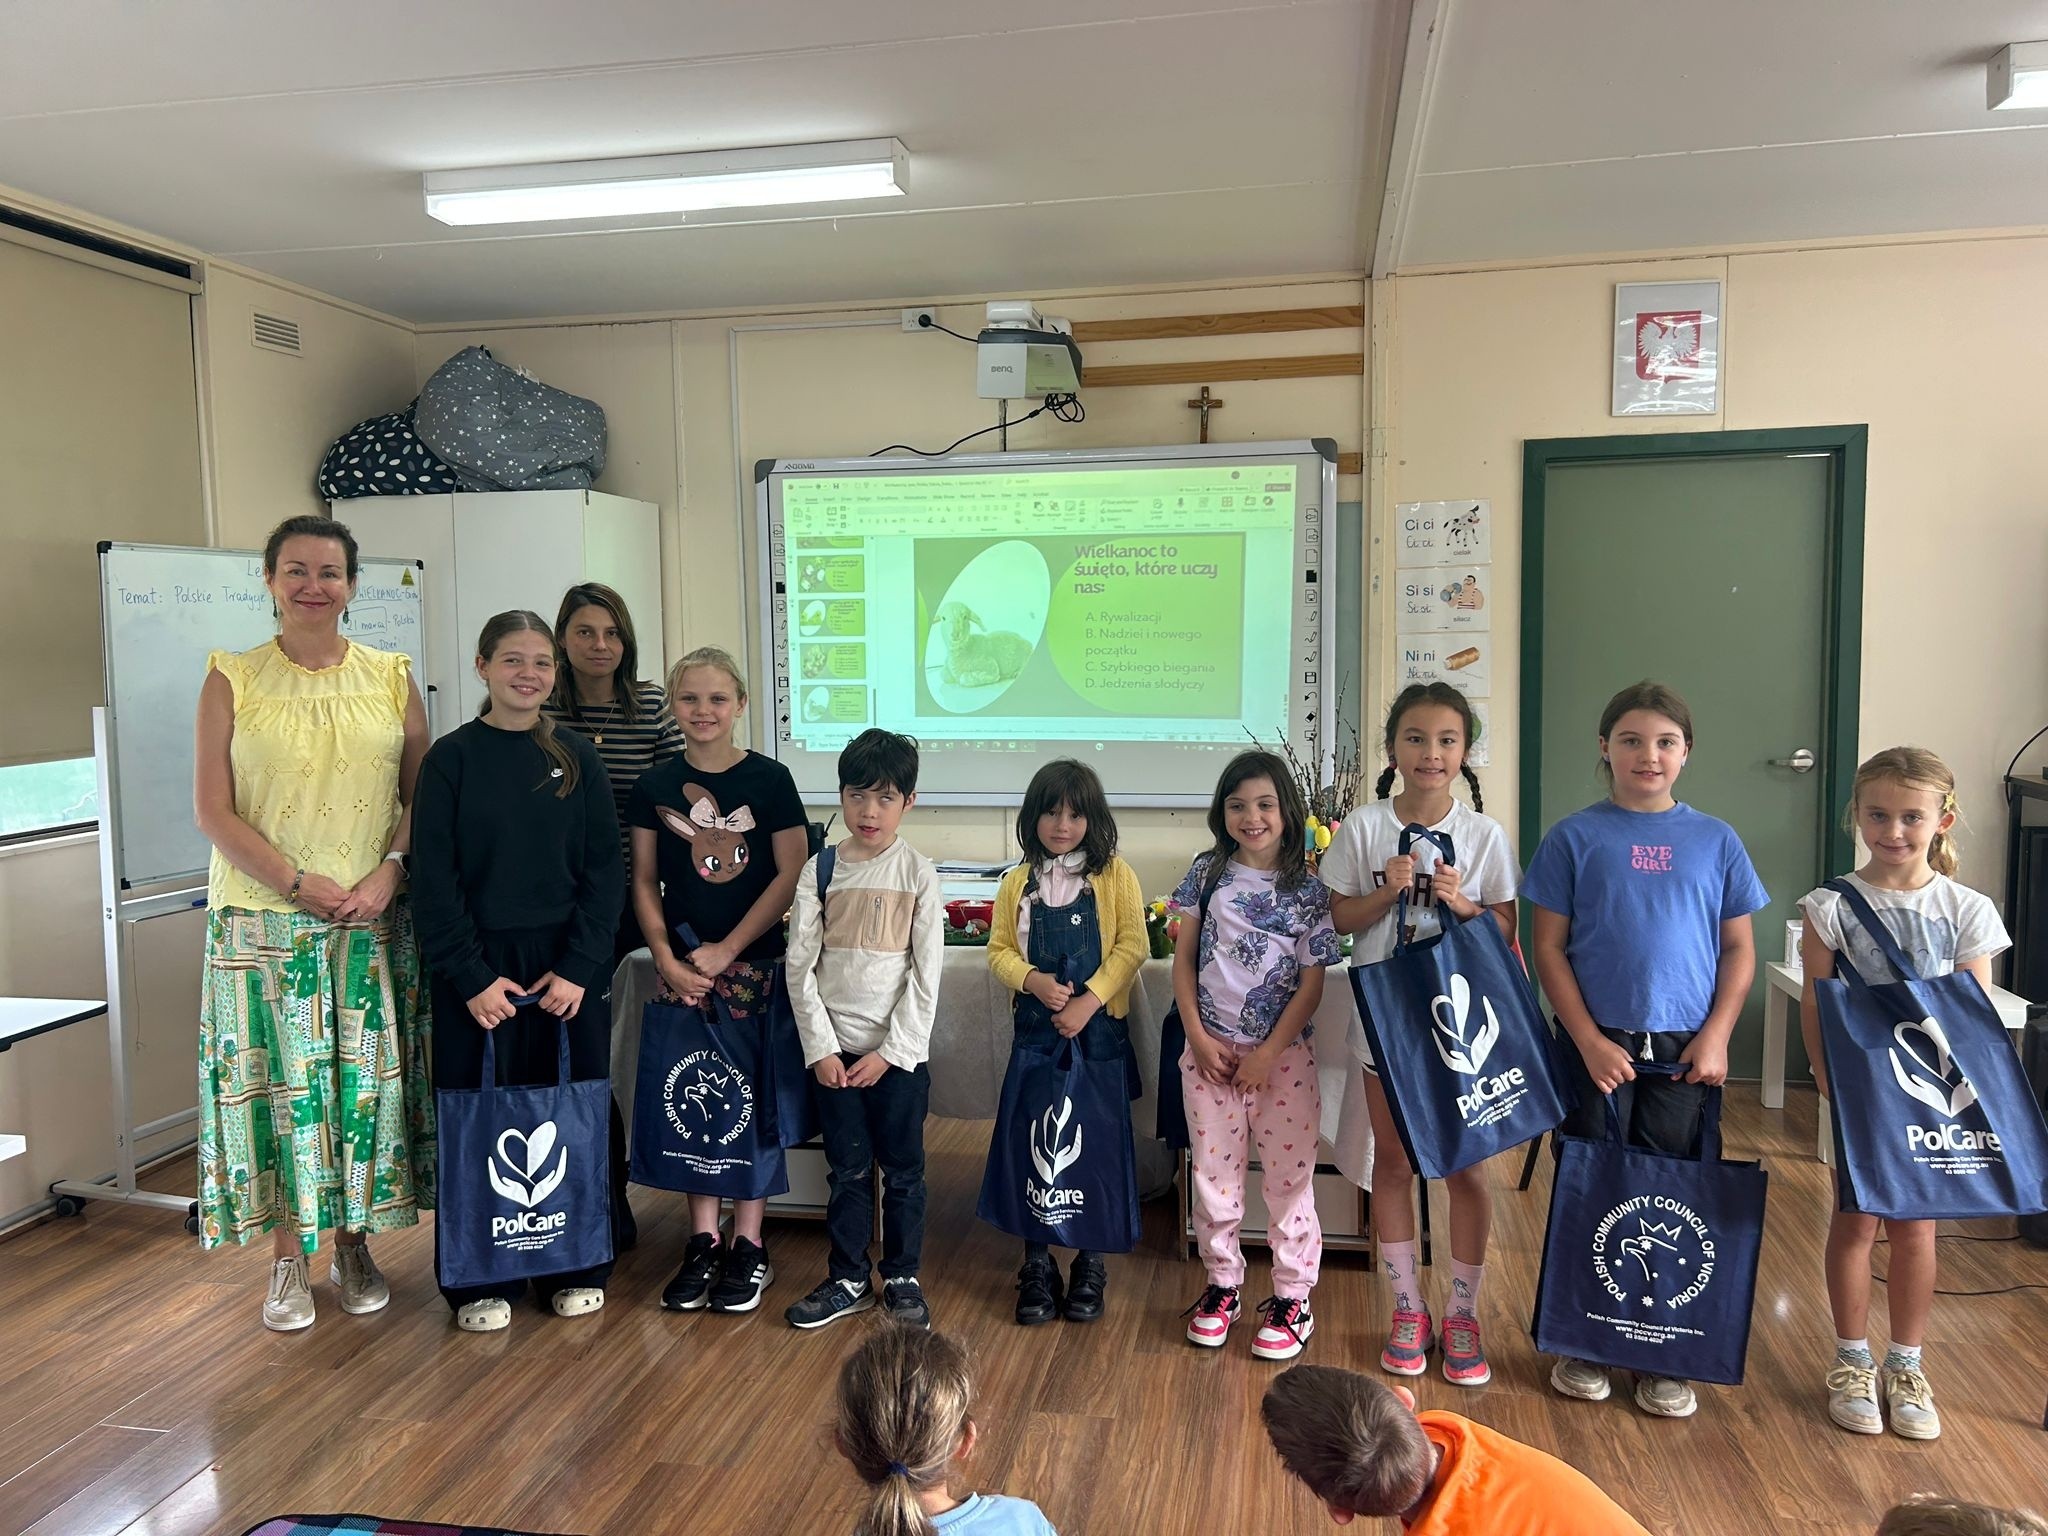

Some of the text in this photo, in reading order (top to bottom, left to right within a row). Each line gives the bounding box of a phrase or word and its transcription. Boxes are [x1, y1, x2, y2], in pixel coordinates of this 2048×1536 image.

[1405, 518, 1434, 531] Ci ci
[1074, 544, 1178, 558] Wielkanoc to
[1074, 561, 1218, 579] święto, które uczy
[1074, 582, 1105, 594] nas:
[1406, 584, 1434, 596] Si si
[118, 587, 163, 605] Temat:
[174, 586, 213, 604] Polskie
[1085, 612, 1162, 624] A. Rywalizacji
[1085, 628, 1097, 639] B.
[1100, 628, 1143, 639] Nadziei
[1153, 631, 1202, 642] nowego
[1085, 646, 1137, 658] początku
[1406, 650, 1435, 662] Ni ni
[1085, 662, 1216, 675] C. Szybkiego biegania
[1085, 678, 1097, 689] D.
[1100, 678, 1151, 689] Jedzenia
[1632, 846, 1672, 860] EVE
[1632, 856, 1672, 871] GIRL
[664, 1050, 709, 1100] COMMUNITY
[741, 1086, 753, 1100] OF
[1456, 1067, 1525, 1120] PolCare
[664, 1102, 692, 1140] POLISH
[718, 1102, 753, 1146] VICTORIA
[1906, 1123, 2002, 1152] PolCare
[1026, 1177, 1084, 1208] PolCare
[492, 1212, 567, 1238] PolCare
[1592, 1196, 1715, 1309] POLISH COMMUNITY COUNCIL OF VICTORIA
[1586, 1312, 1606, 1321] Polish
[1606, 1316, 1640, 1328] Community
[1640, 1322, 1664, 1331] Council
[1671, 1326, 1694, 1334] Victoria
[1616, 1326, 1676, 1340] www.pccv.org.au
